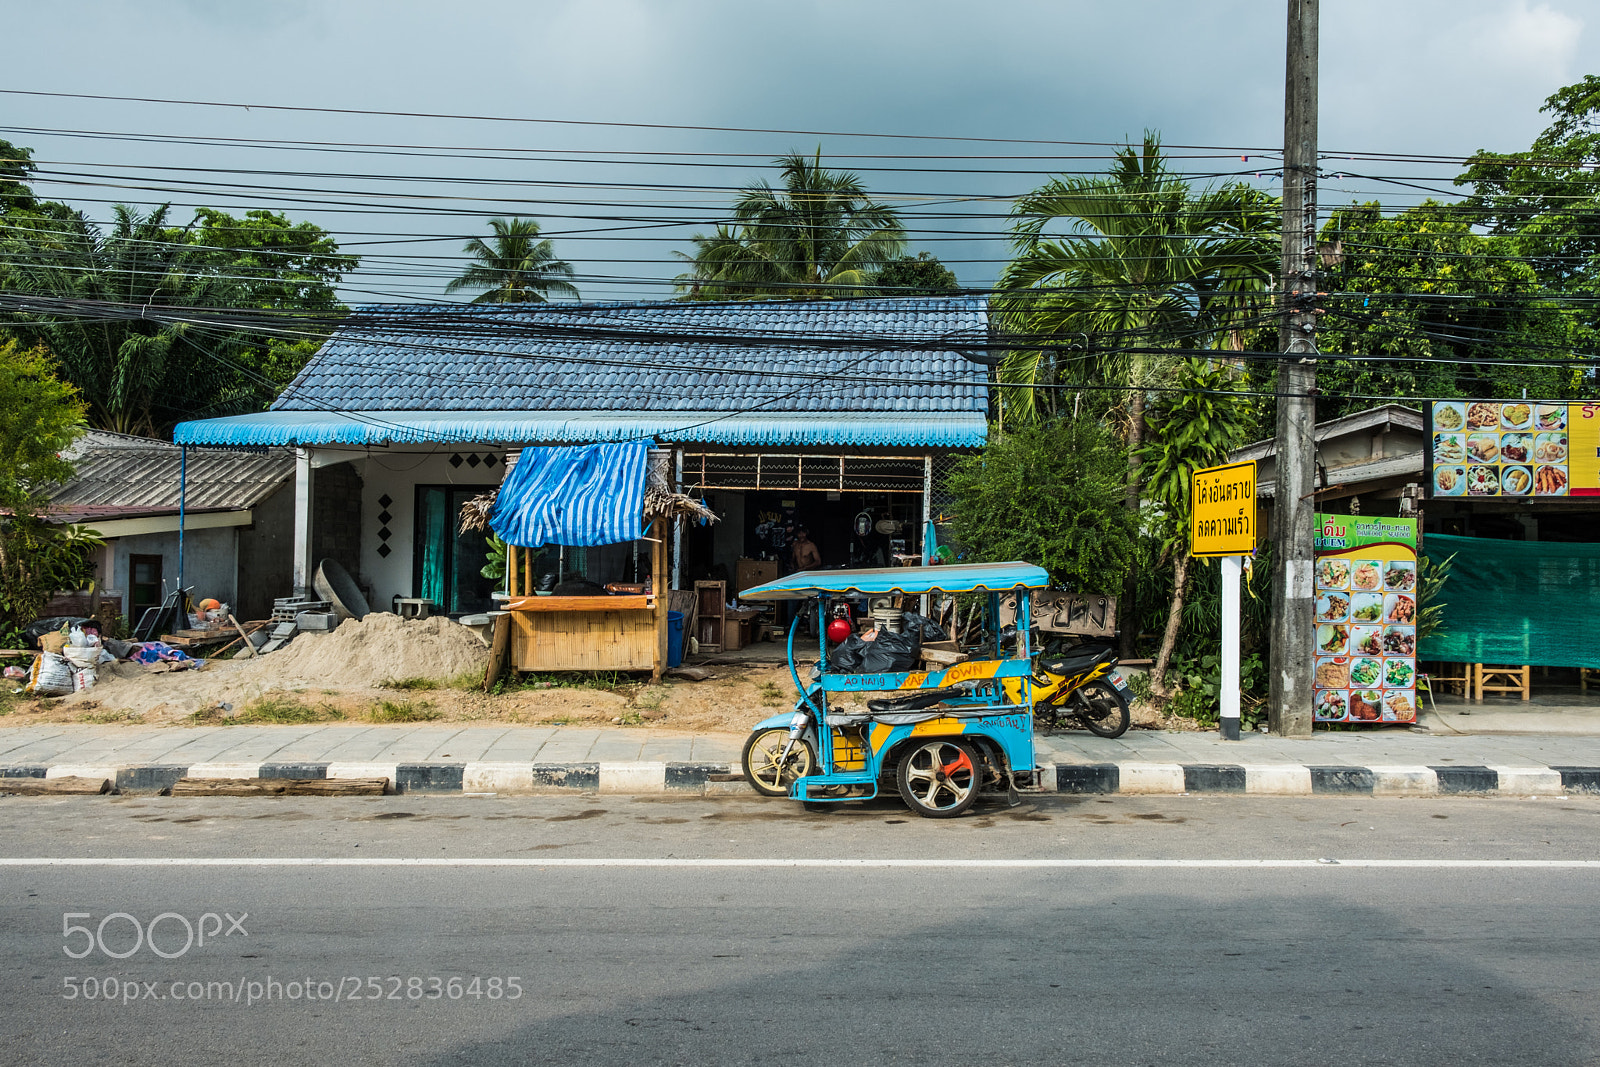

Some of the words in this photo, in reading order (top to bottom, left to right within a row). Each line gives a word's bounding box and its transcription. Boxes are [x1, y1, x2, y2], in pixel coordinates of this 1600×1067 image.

[1196, 478, 1251, 505] โค้งอันตราย
[1198, 507, 1249, 537] ลดความเร็ว
[945, 664, 982, 683] TOWN
